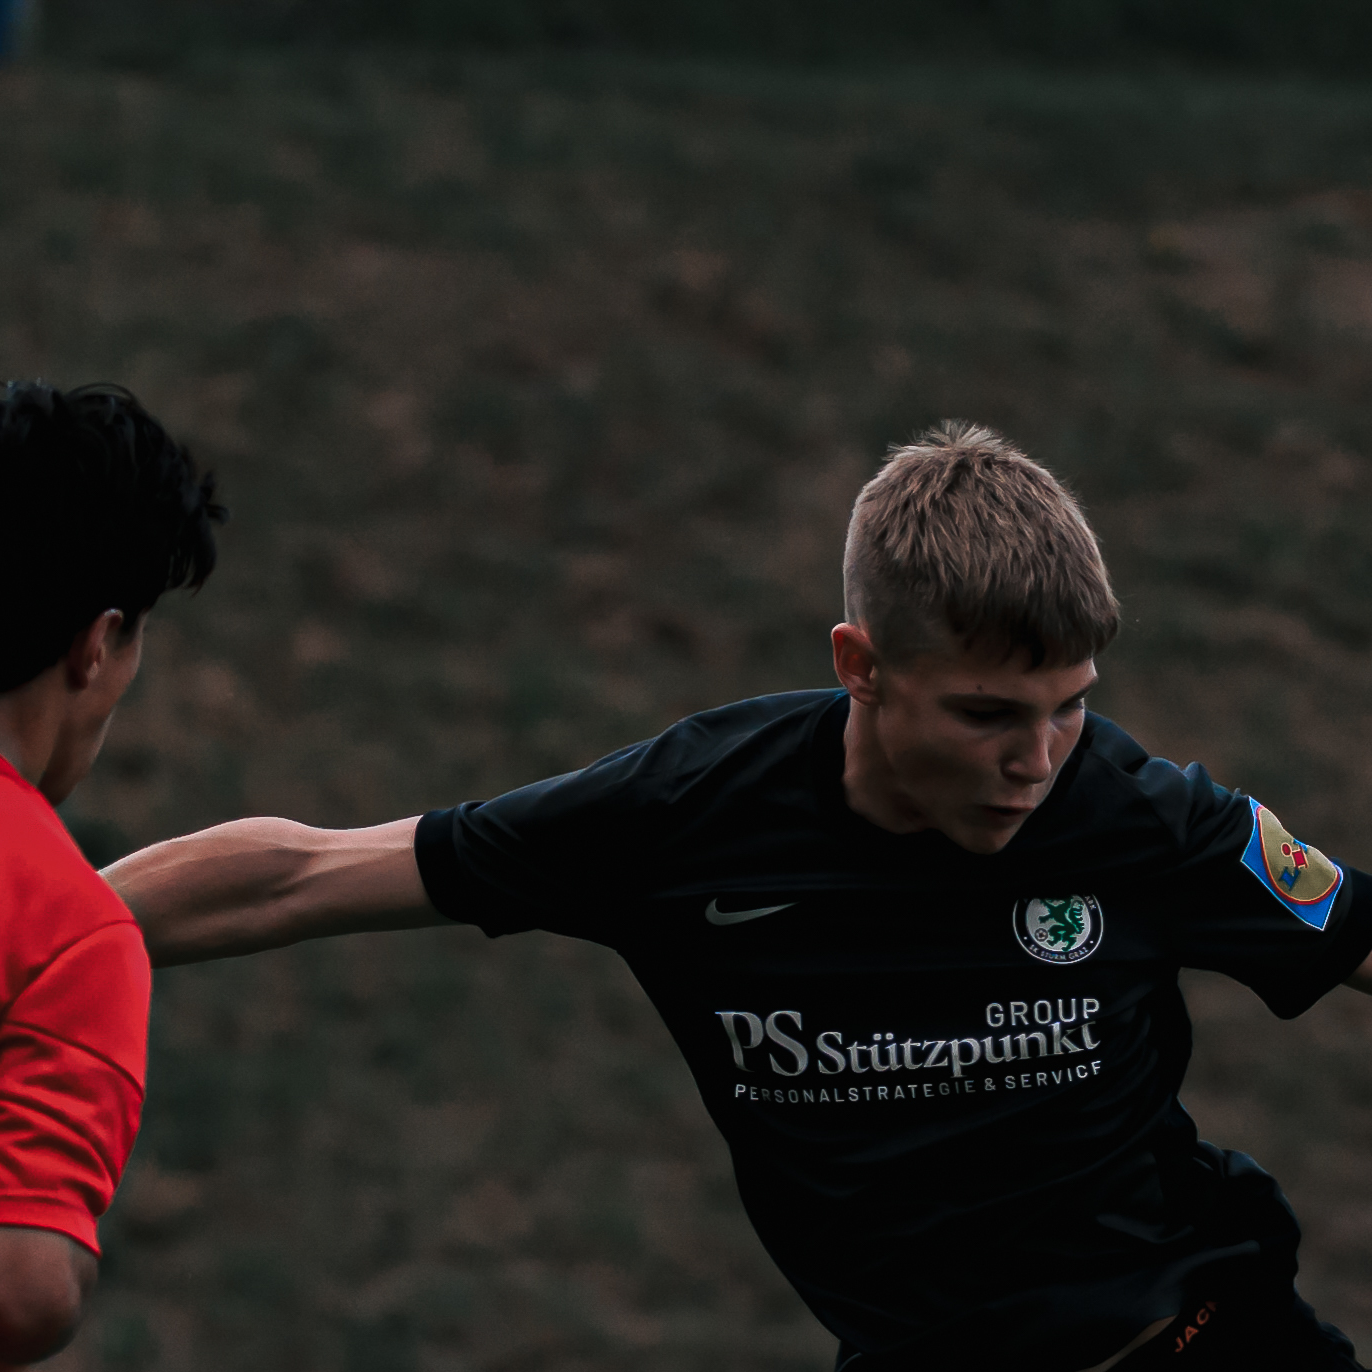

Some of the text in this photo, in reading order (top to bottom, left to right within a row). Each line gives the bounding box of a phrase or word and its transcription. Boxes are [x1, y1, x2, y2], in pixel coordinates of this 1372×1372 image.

[985, 998, 1100, 1028] GROUP
[714, 1010, 1102, 1079] PS Stützpunkt
[733, 1079, 977, 1104] PERSONALSTRATEGIE
[984, 1078, 998, 1092] &
